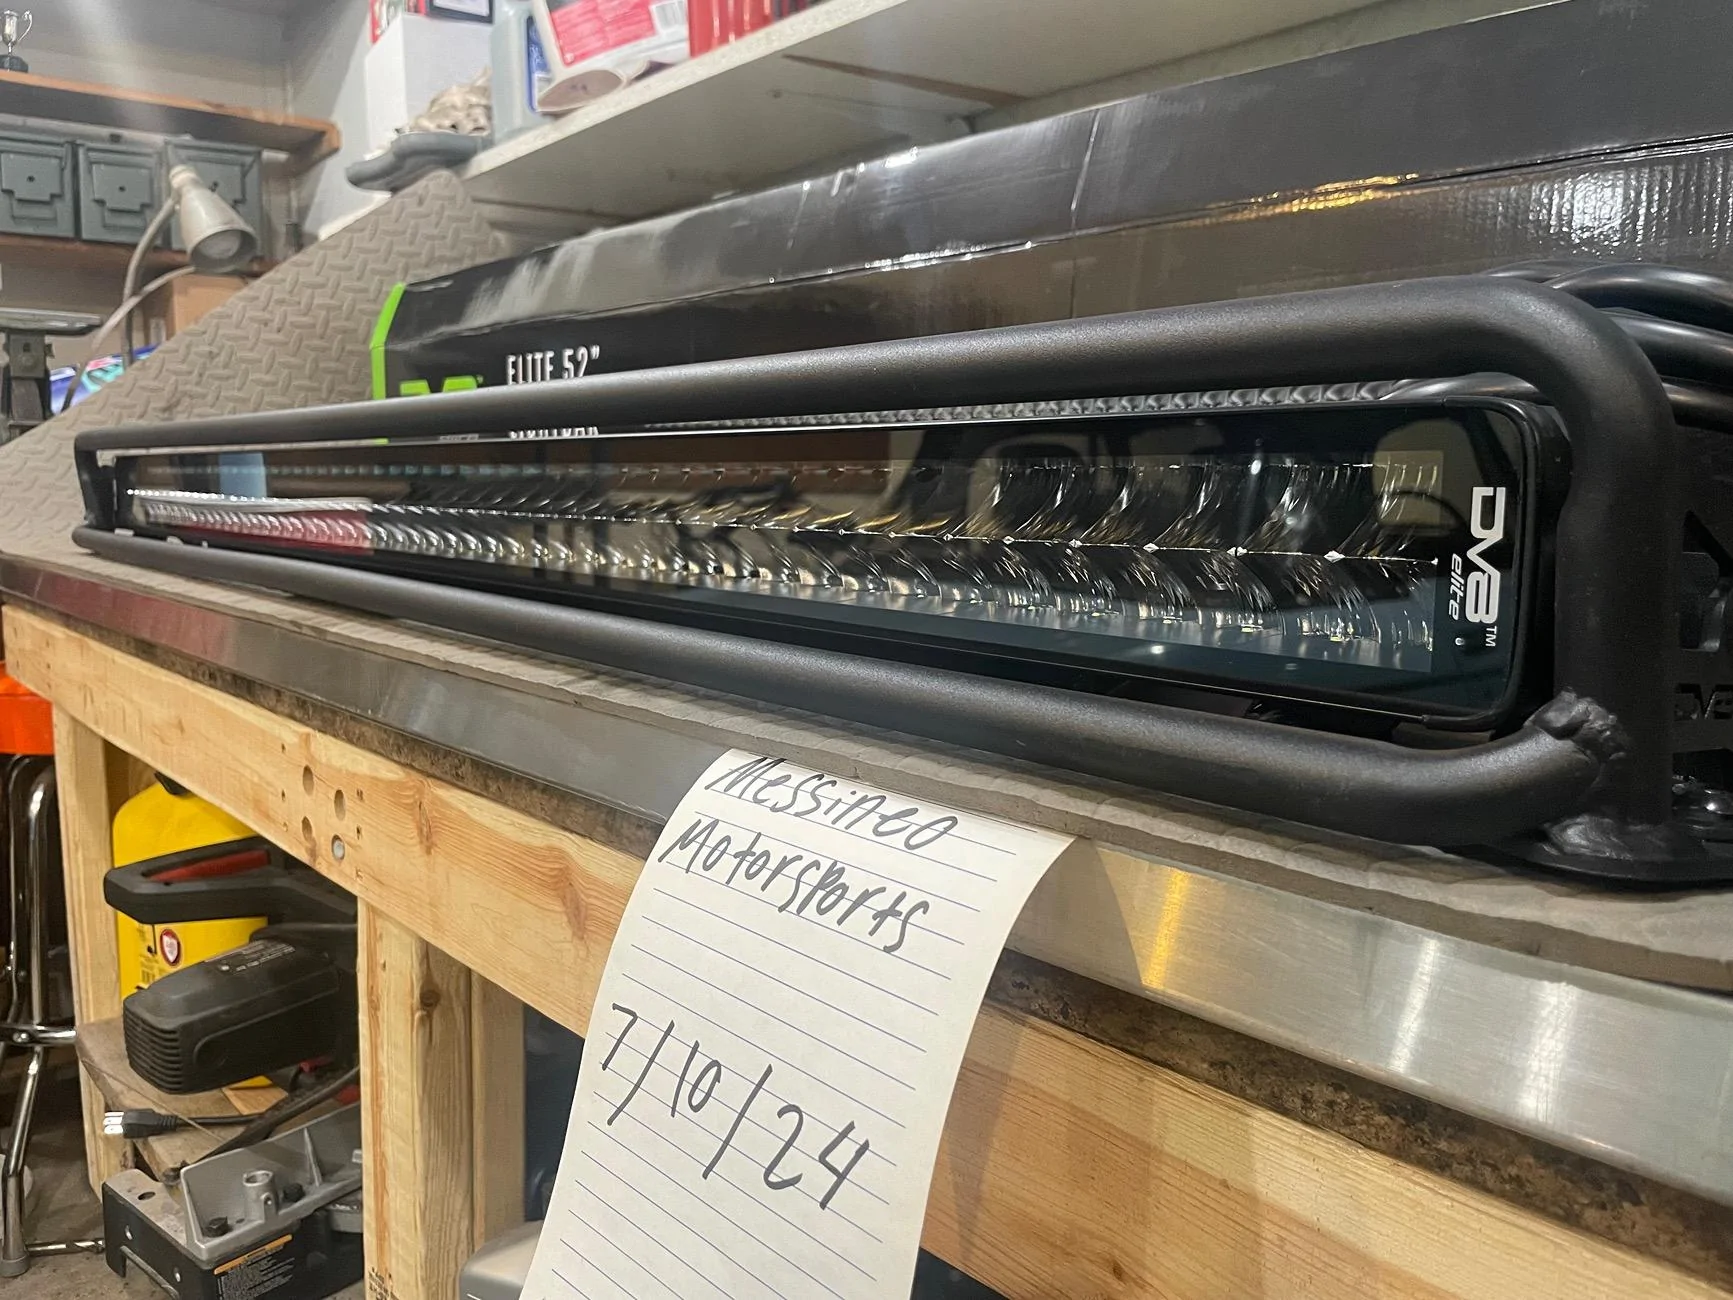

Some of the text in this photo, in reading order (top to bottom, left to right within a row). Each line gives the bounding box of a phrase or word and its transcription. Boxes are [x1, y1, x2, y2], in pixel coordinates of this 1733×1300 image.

[506, 350, 555, 385] ELITE
[1449, 553, 1465, 621] elite
[704, 757, 958, 850] Messineo
[602, 1002, 870, 1210] 7/10/24
